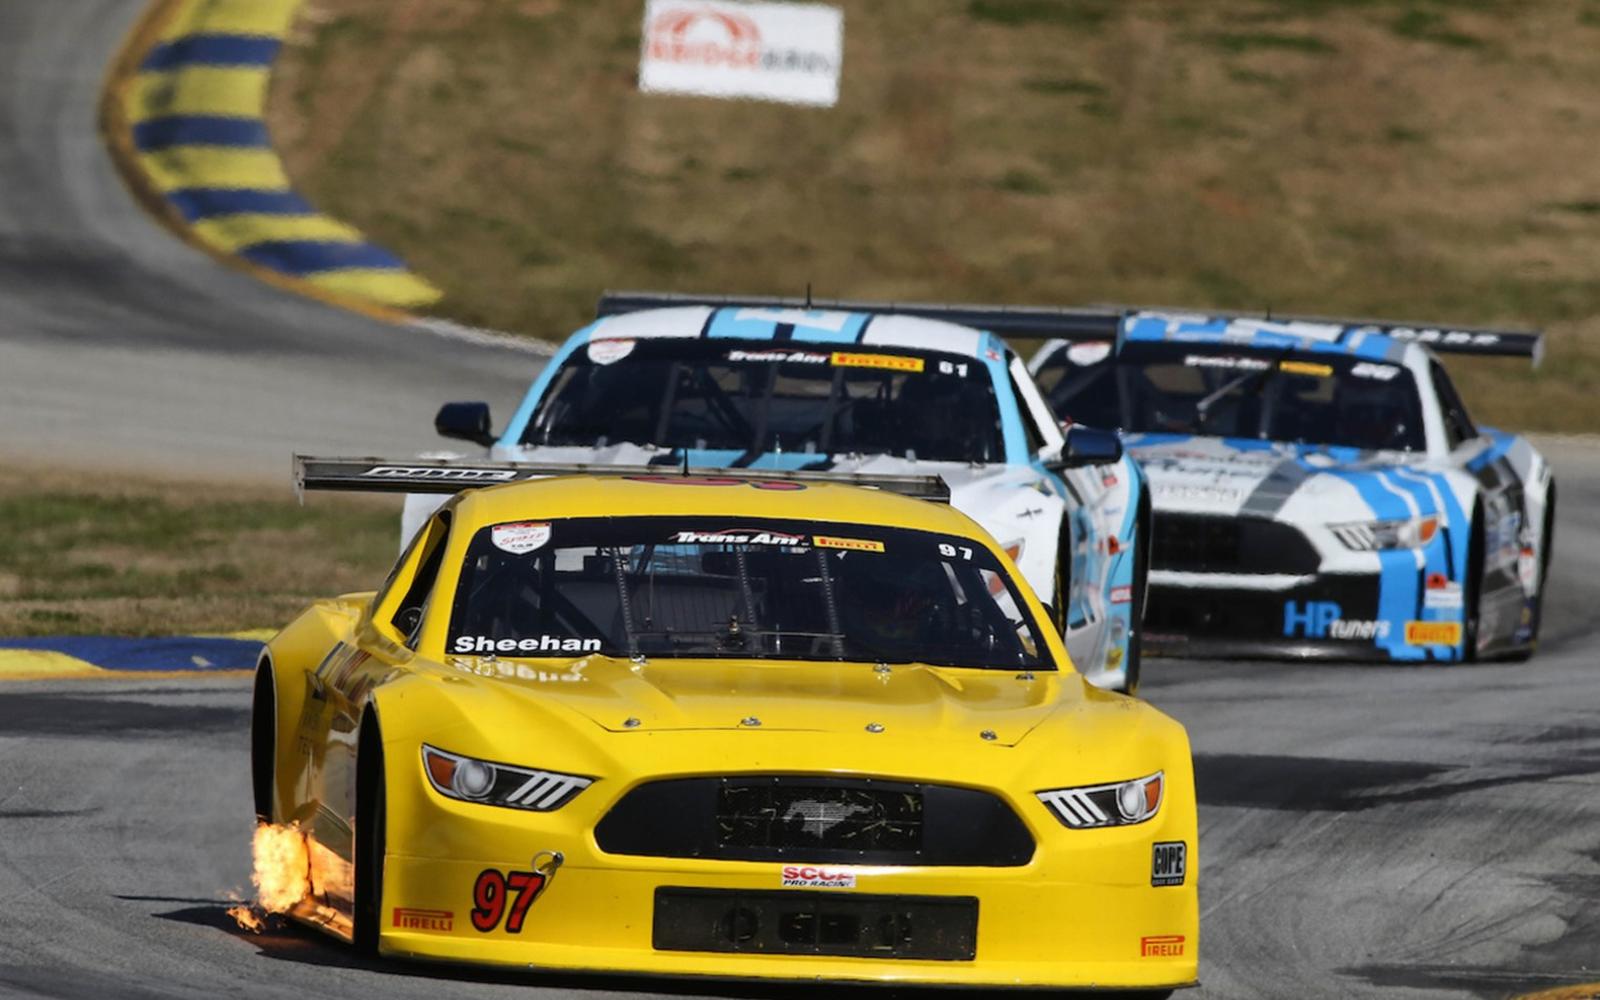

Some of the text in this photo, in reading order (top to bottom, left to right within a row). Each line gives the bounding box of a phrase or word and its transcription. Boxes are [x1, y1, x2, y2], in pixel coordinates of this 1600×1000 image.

[677, 531, 799, 546] Trans Am
[819, 537, 878, 550] PIRELLI
[938, 543, 973, 561] 97
[1284, 600, 1342, 638] HP
[454, 635, 602, 653] Sheehan
[1154, 846, 1183, 874] COPE
[471, 868, 546, 934] 97
[392, 907, 454, 931] PIRELLI
[1141, 936, 1185, 957] PIRELLI
